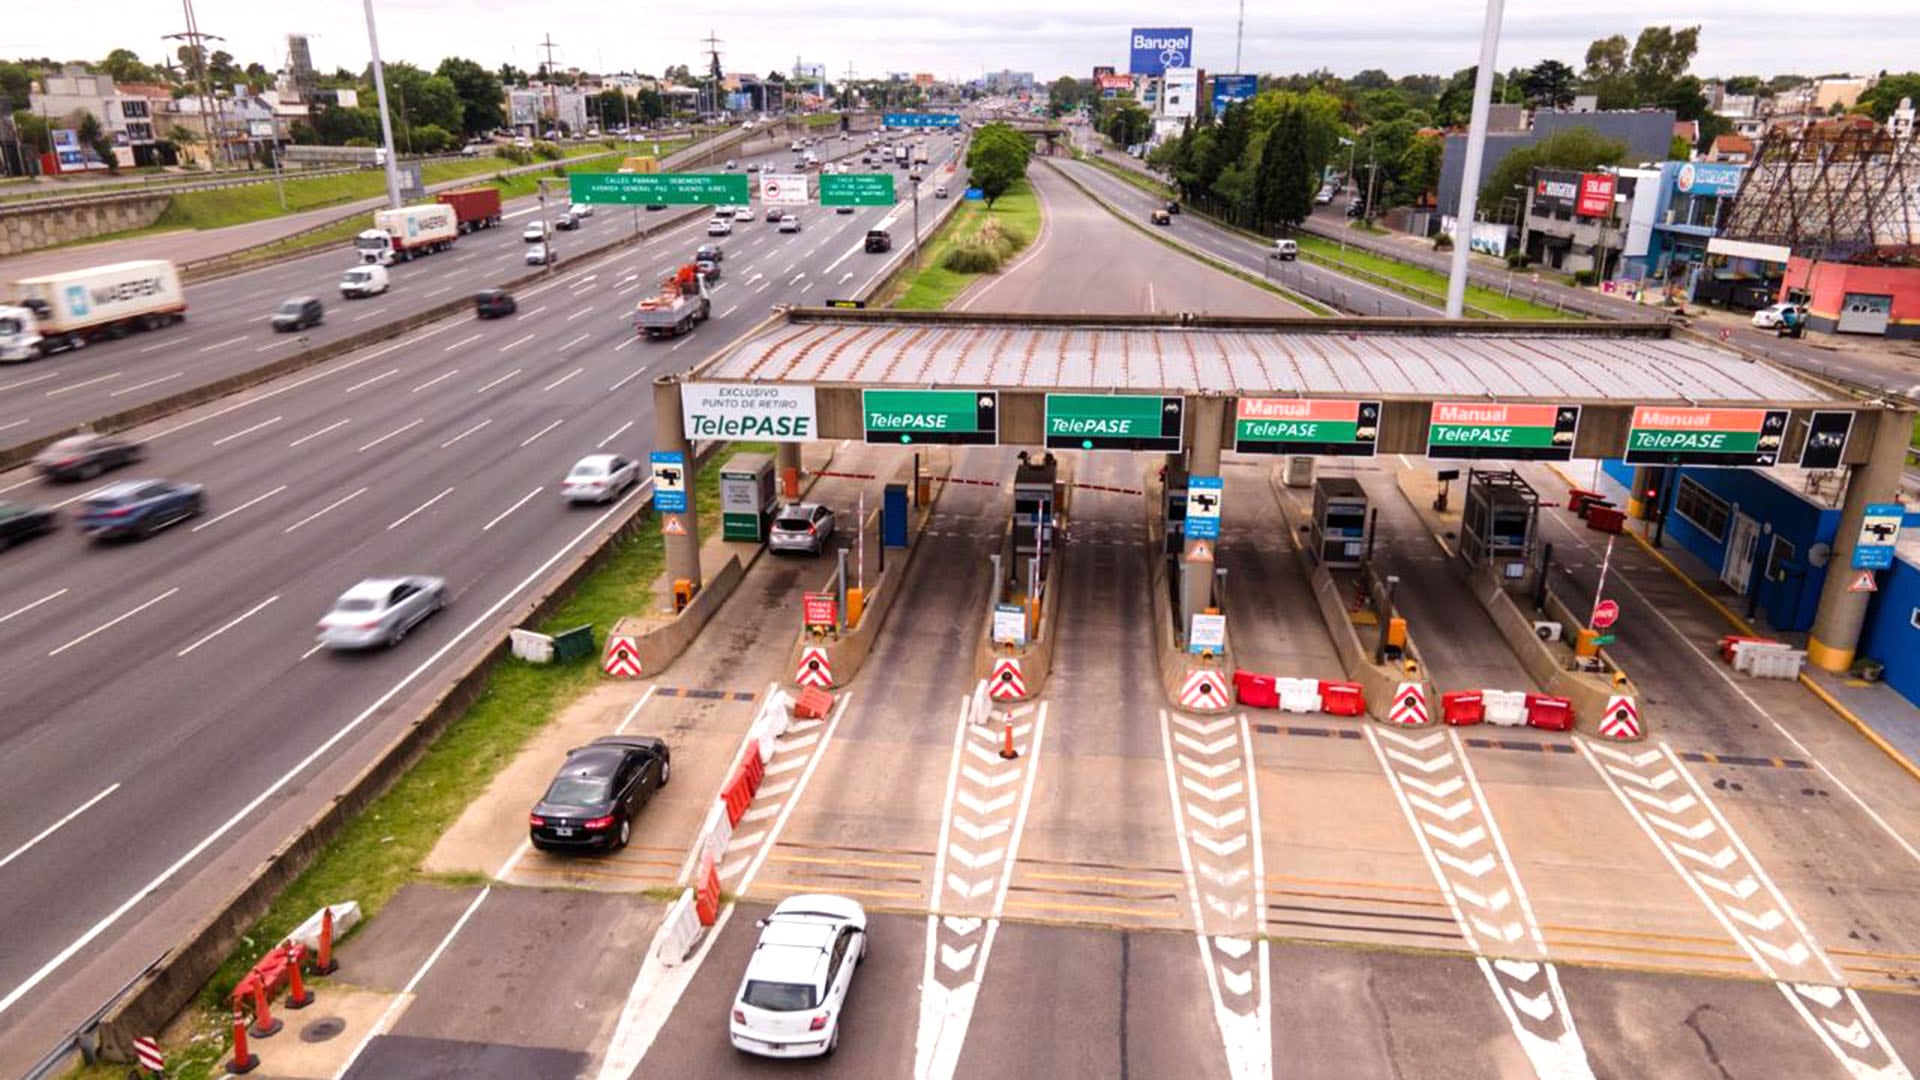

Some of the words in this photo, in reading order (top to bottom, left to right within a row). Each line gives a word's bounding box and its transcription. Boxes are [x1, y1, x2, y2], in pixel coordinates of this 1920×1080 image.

[1134, 35, 1189, 50] Barugel
[654, 185, 668, 193] PAZ
[719, 387, 779, 398] EXCLUSIVO
[702, 399, 739, 408] PUNTO
[741, 400, 756, 408] DE
[758, 400, 798, 409] RETIRO
[1245, 399, 1311, 416] Manual
[870, 412, 948, 428] TelePASE
[1439, 405, 1508, 422] Manual
[1641, 411, 1711, 427] Manual
[691, 414, 810, 436] TelePASE
[1052, 418, 1132, 433] TelePASE
[1245, 421, 1319, 437] TelePASE
[1436, 427, 1513, 442] TelePASE
[1636, 432, 1727, 449] TelePASE
